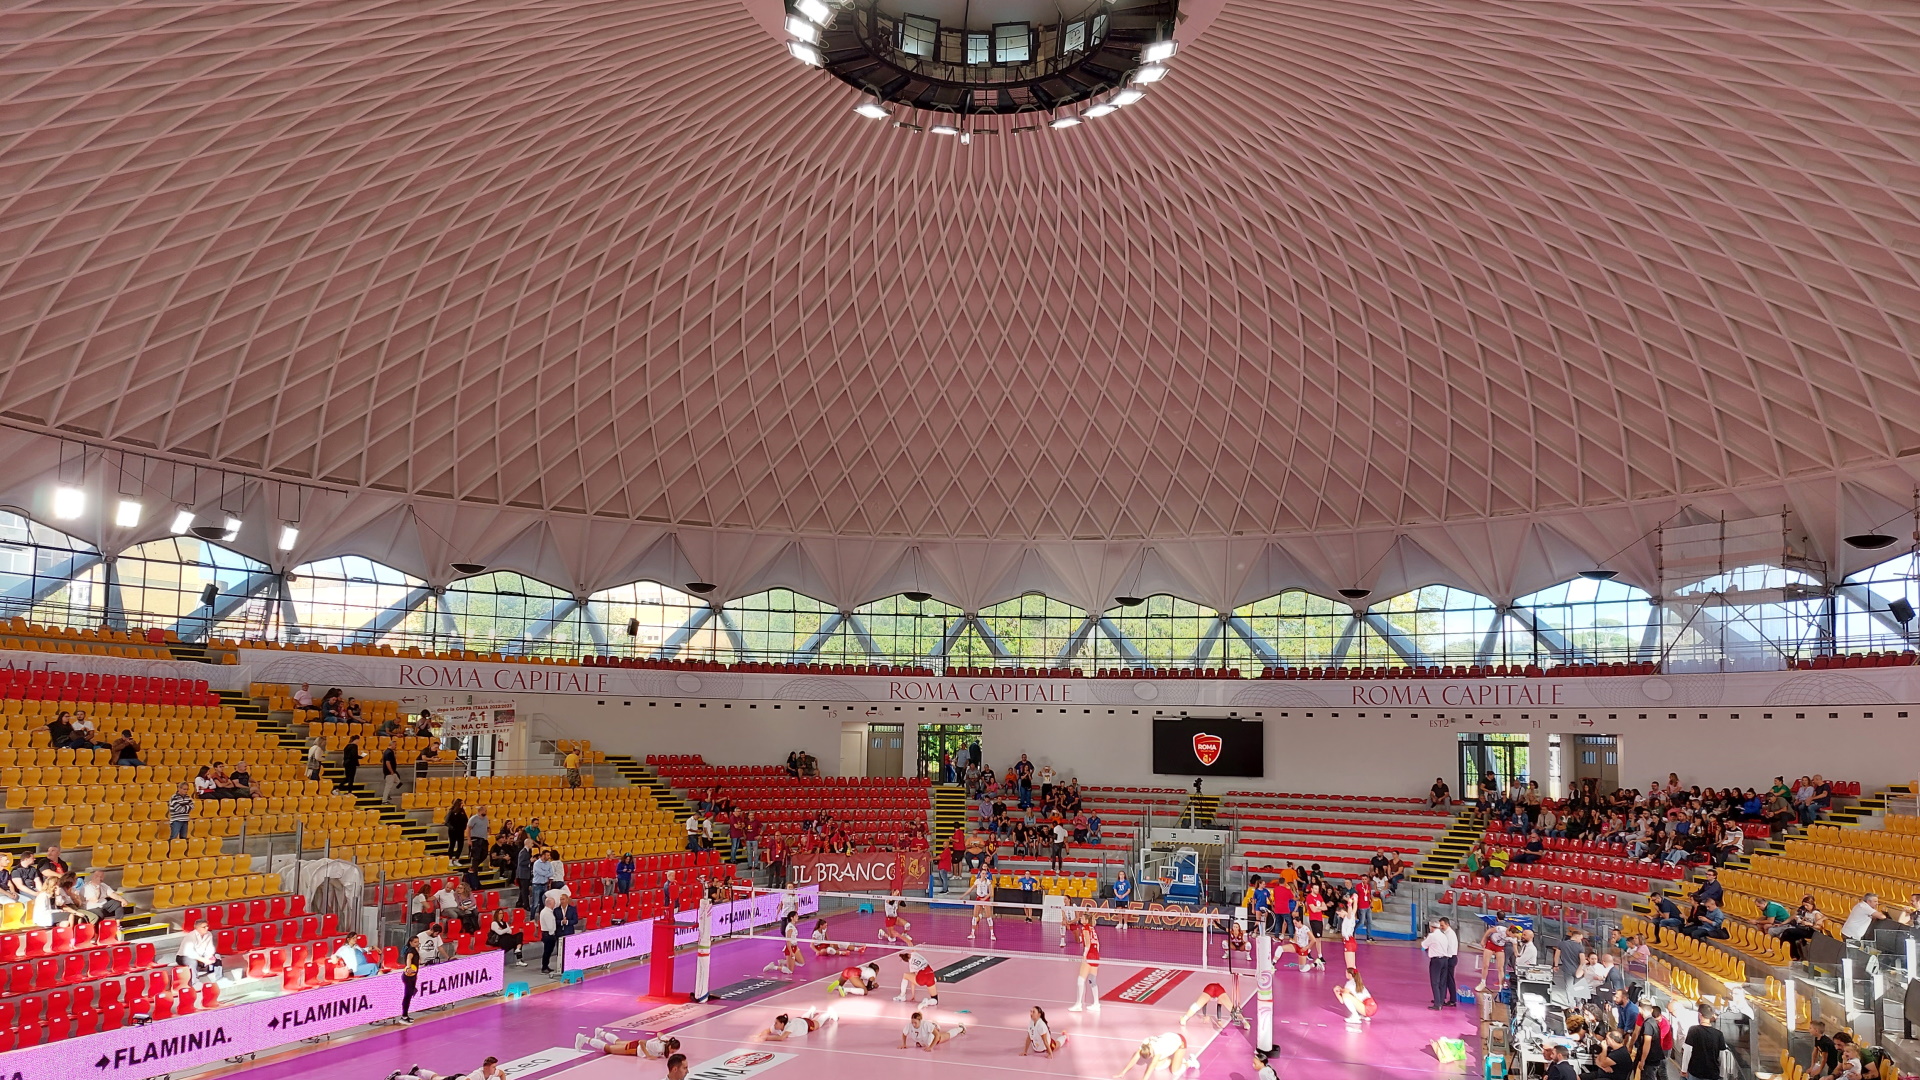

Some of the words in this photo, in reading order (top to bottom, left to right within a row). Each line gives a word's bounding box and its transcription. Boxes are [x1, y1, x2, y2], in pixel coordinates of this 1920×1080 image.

[399, 664, 484, 689] ROMA
[493, 669, 610, 693] CAPITALE
[442, 696, 455, 705] T4
[889, 681, 961, 700] ROMA
[969, 683, 1073, 702] CAPITALE
[1352, 685, 1432, 706] ROMA
[1442, 683, 1565, 706] CAPITALE
[1197, 743, 1217, 751] ROMA
[793, 864, 812, 885] IL
[1145, 902, 1221, 929] ROMA
